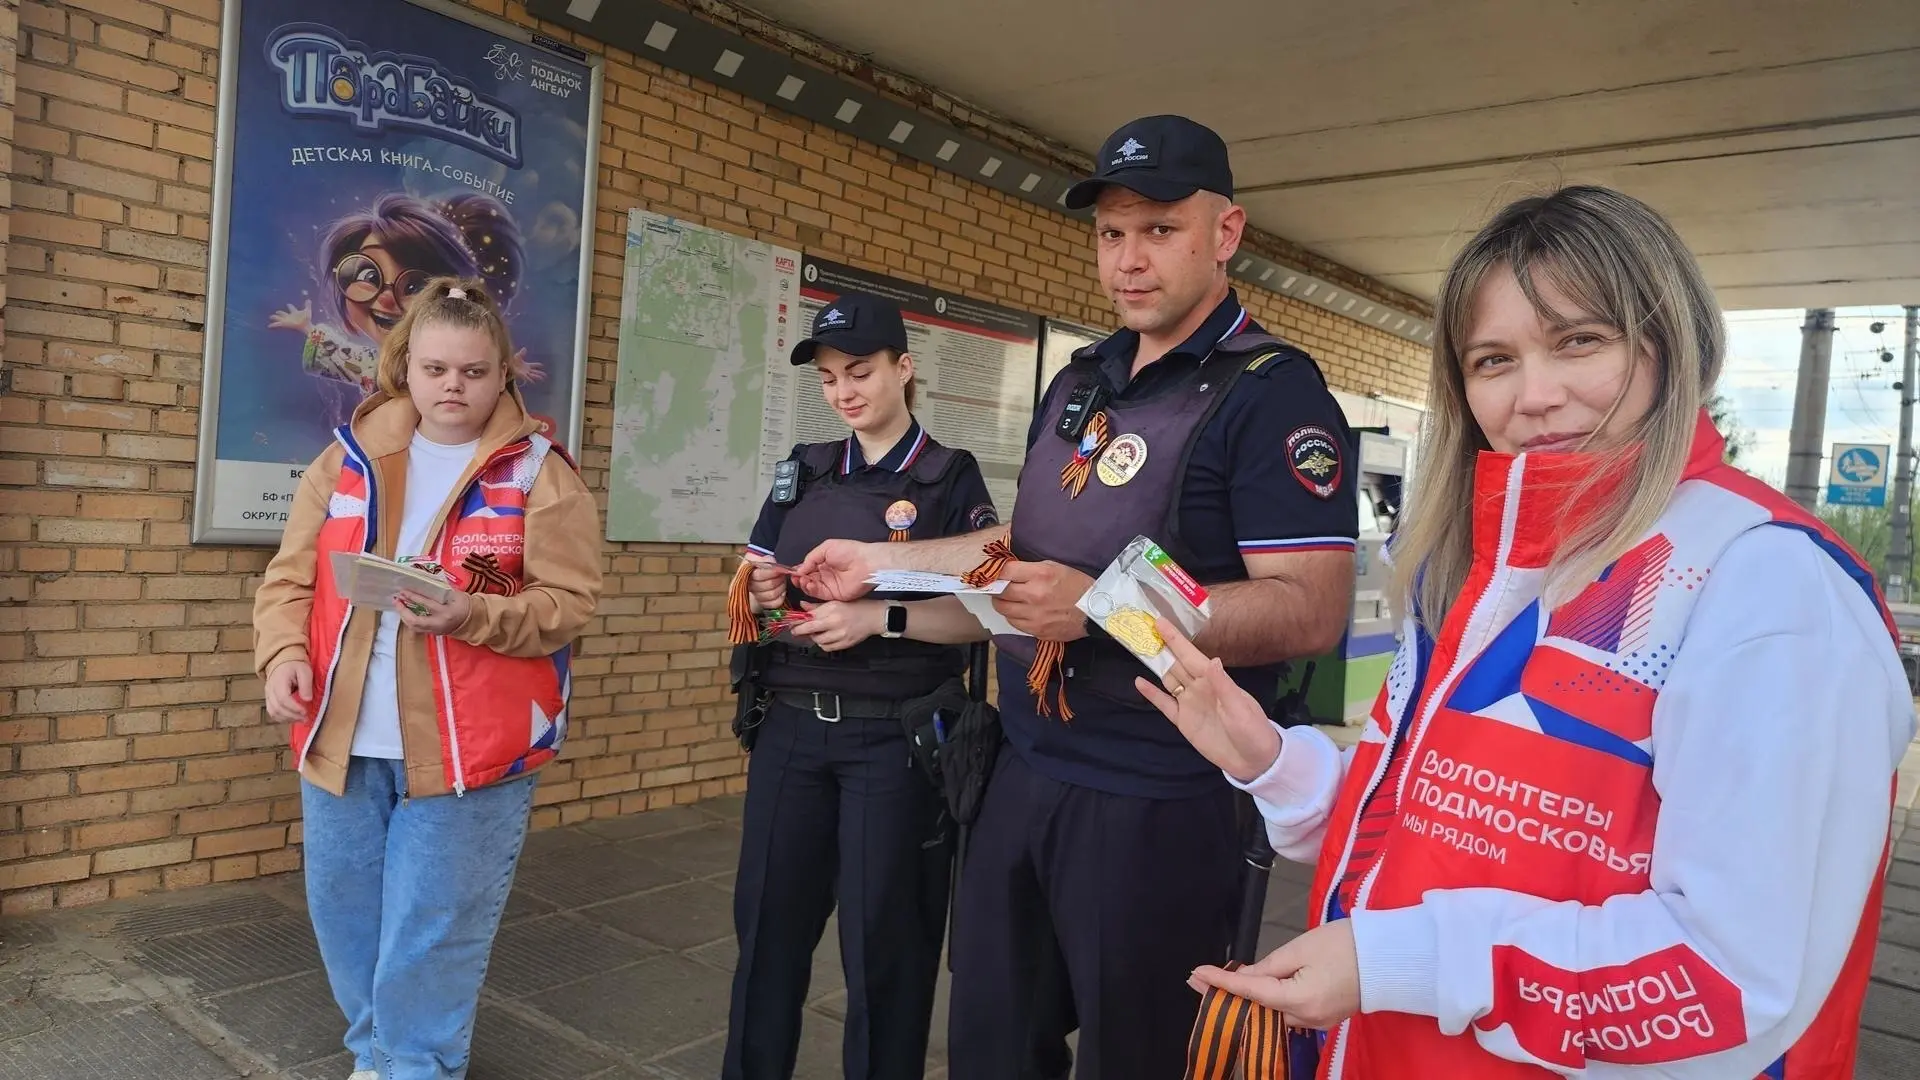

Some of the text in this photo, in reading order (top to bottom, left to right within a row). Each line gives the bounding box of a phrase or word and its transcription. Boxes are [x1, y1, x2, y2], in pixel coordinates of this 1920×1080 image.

[530, 79, 570, 98] АНГЕЛУ
[531, 65, 582, 91] ПОДАРОК
[276, 37, 511, 154] ПараБайки
[291, 147, 516, 205] ДЕТСКАЯ КНИГА-СОБЫТИЕ
[775, 255, 795, 269] КАРТА
[1295, 439, 1335, 459] РОССИЯ
[262, 492, 278, 502] БФ
[242, 511, 277, 521] ОКРУГ
[452, 545, 523, 557] ПОДМОСКО
[1420, 750, 1613, 831] ВОЛОНТЕРЫ
[1411, 777, 1652, 875] ПОДМОСКОВЬЯ
[1402, 813, 1508, 865] МЫ РЯДОМ
